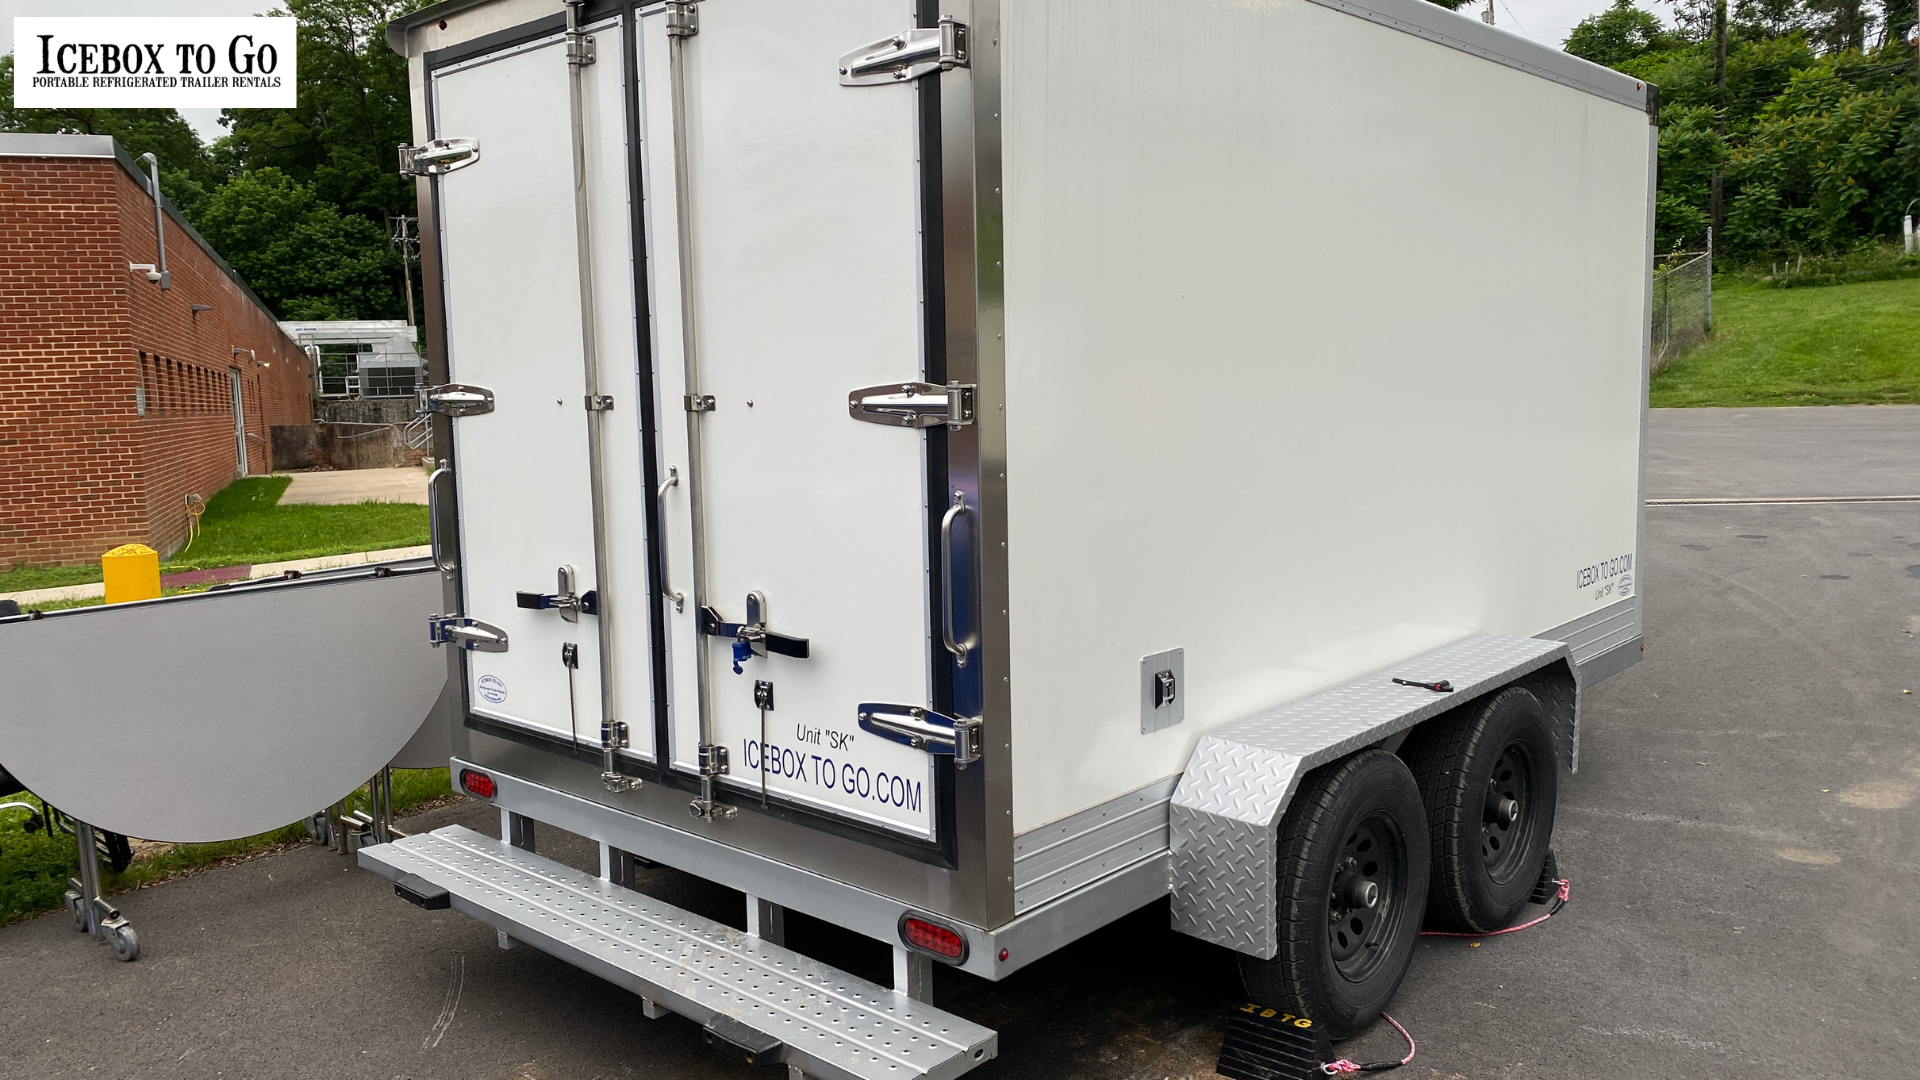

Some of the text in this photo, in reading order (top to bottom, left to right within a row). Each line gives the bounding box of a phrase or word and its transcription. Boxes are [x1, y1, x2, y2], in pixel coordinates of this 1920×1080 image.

[1576, 564, 1600, 590] ICEBOX
[1600, 561, 1609, 581] TO
[796, 723, 855, 752] Unit "SK"
[743, 738, 922, 814] ICEBOX TO GO.COM
[1240, 1003, 1313, 1029] IBTG
